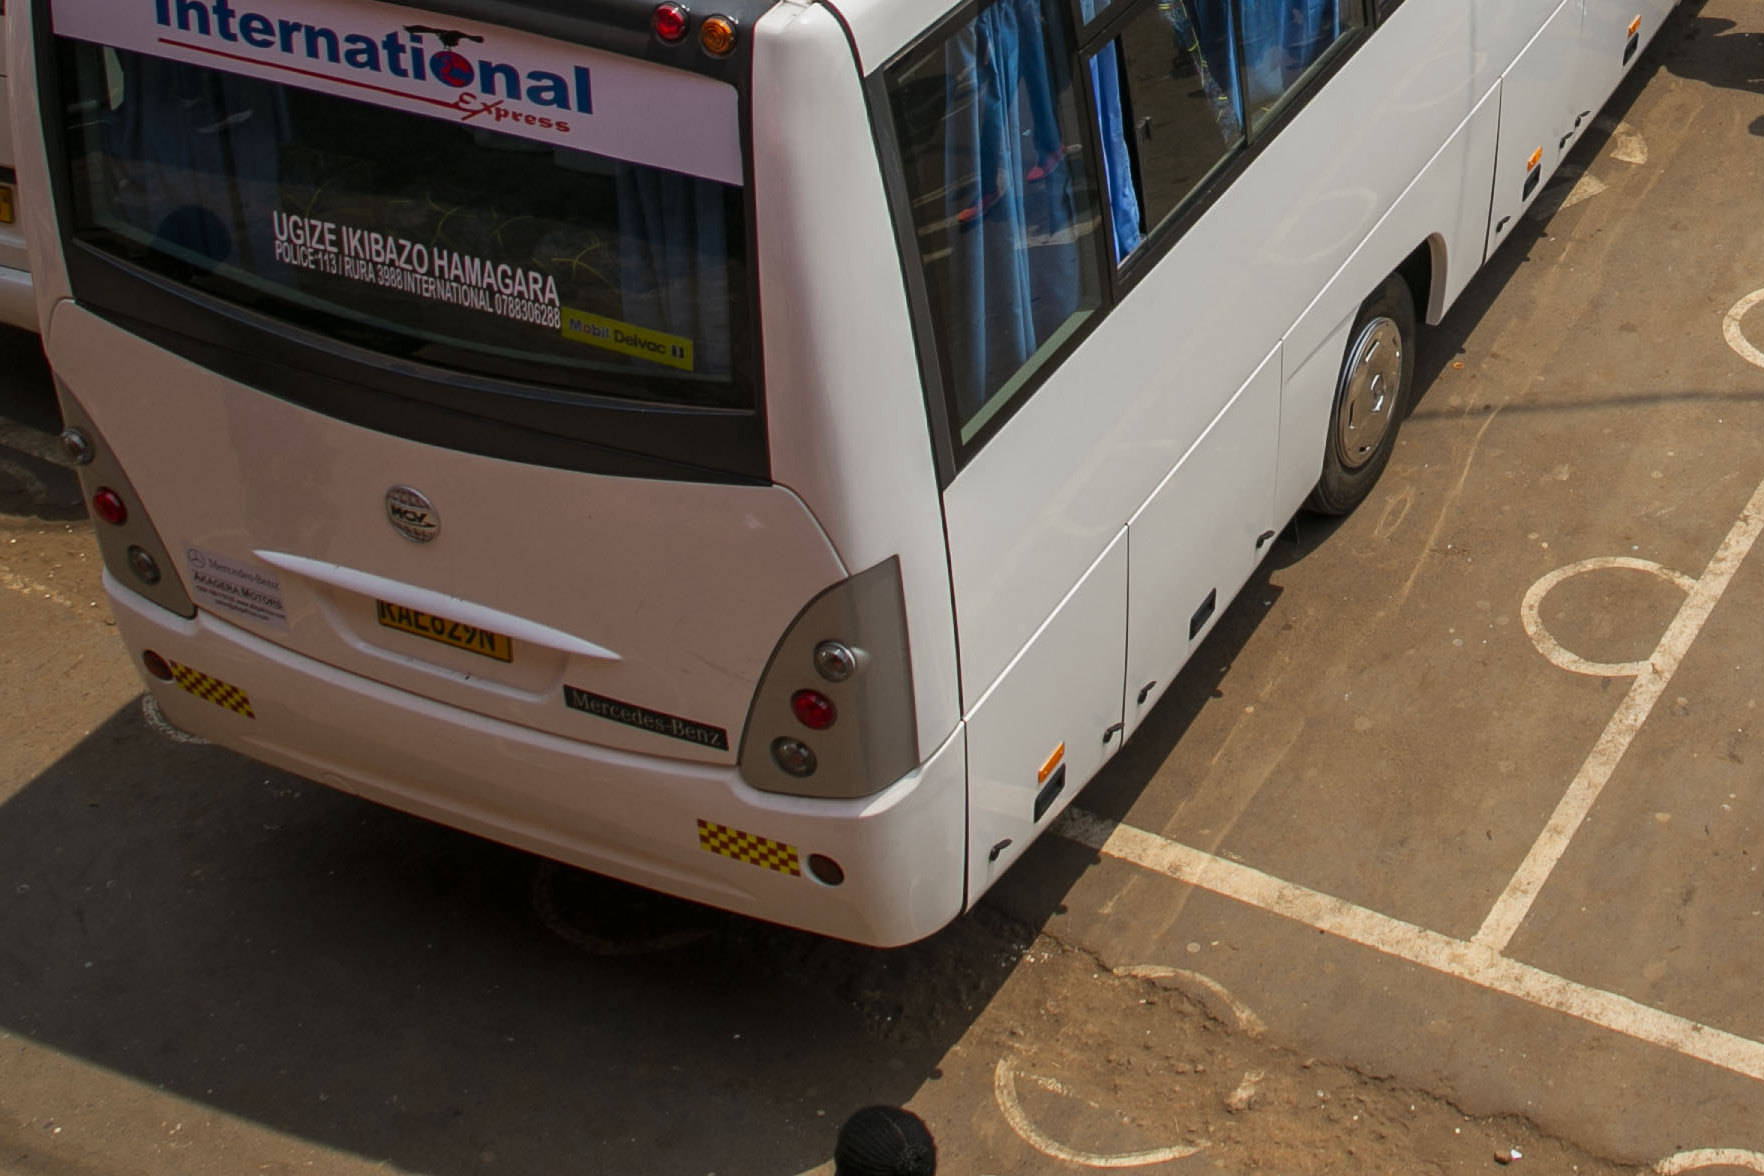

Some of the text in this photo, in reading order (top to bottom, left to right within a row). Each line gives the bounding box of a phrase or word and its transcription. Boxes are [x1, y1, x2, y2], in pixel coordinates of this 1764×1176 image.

[453, 91, 571, 134] Express
[273, 210, 560, 307] UGIZE IKIBAZO HAMAGARA
[344, 257, 375, 283] RURA
[404, 271, 494, 313] INTERNATIONAL
[494, 293, 561, 330] 0788306288
[568, 318, 610, 339] Mobil
[613, 329, 667, 355] Delvac
[571, 690, 723, 747] Mercedes-Benz
